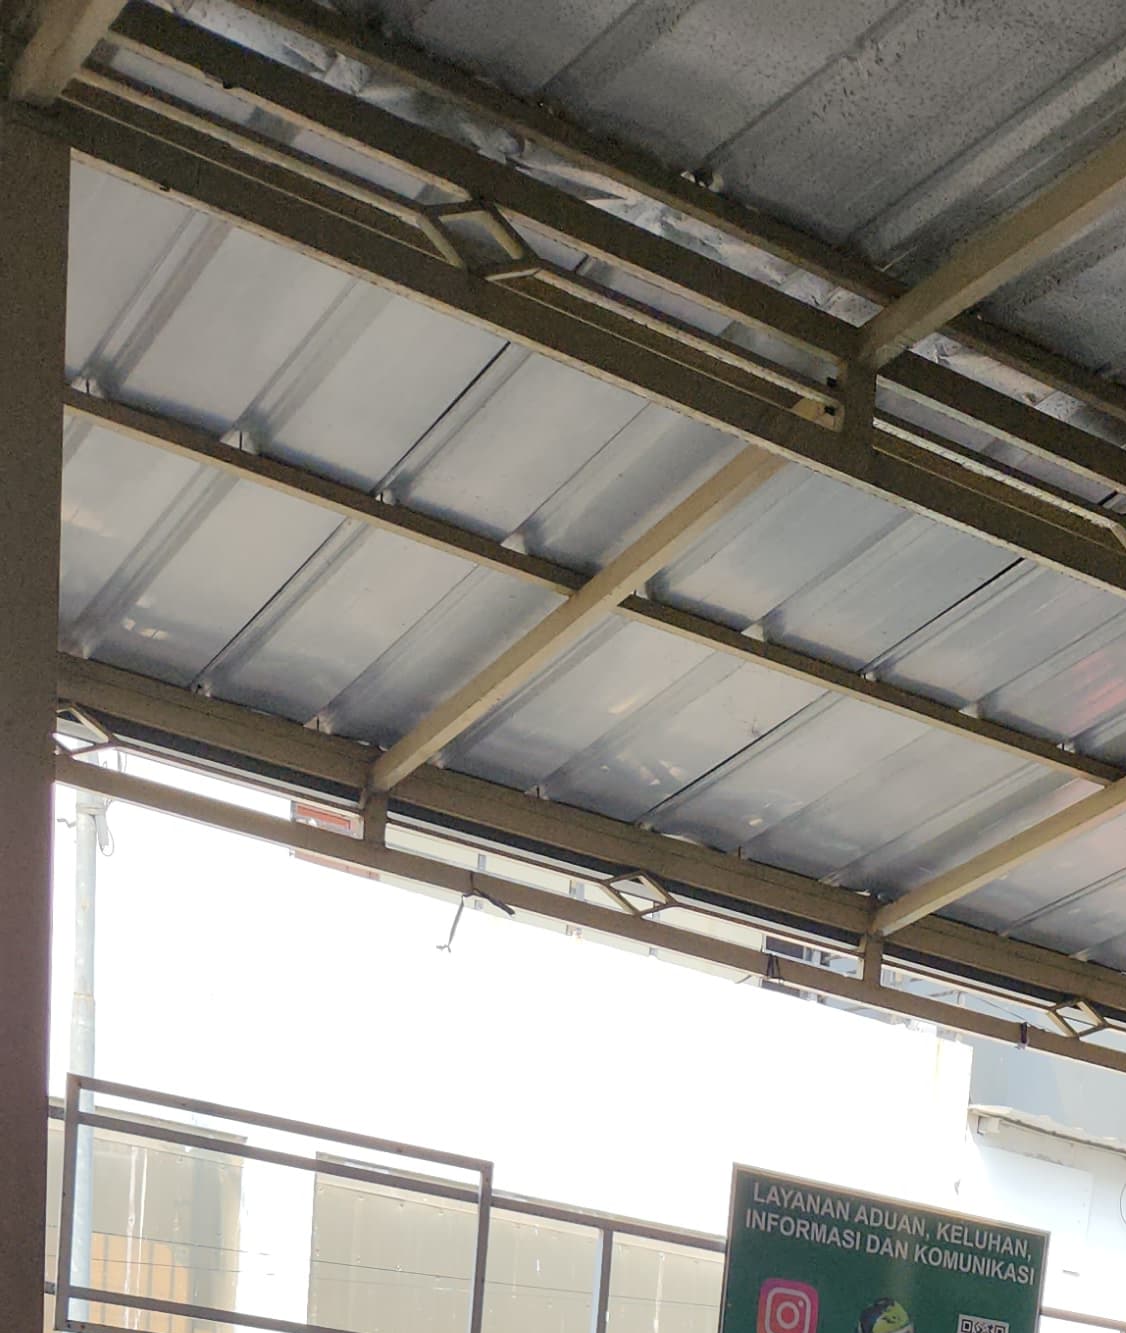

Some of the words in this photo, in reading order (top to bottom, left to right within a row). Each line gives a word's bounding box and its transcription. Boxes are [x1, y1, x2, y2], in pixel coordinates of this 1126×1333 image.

[746, 1208, 861, 1250] INFORMASI
[866, 1233, 908, 1260] DAN
[914, 1243, 1035, 1286] KOMUNIKASI
[753, 1182, 850, 1221] LAYANAN
[854, 1204, 930, 1241] ADUAN,
[936, 1221, 1032, 1262] KELUHAN,
